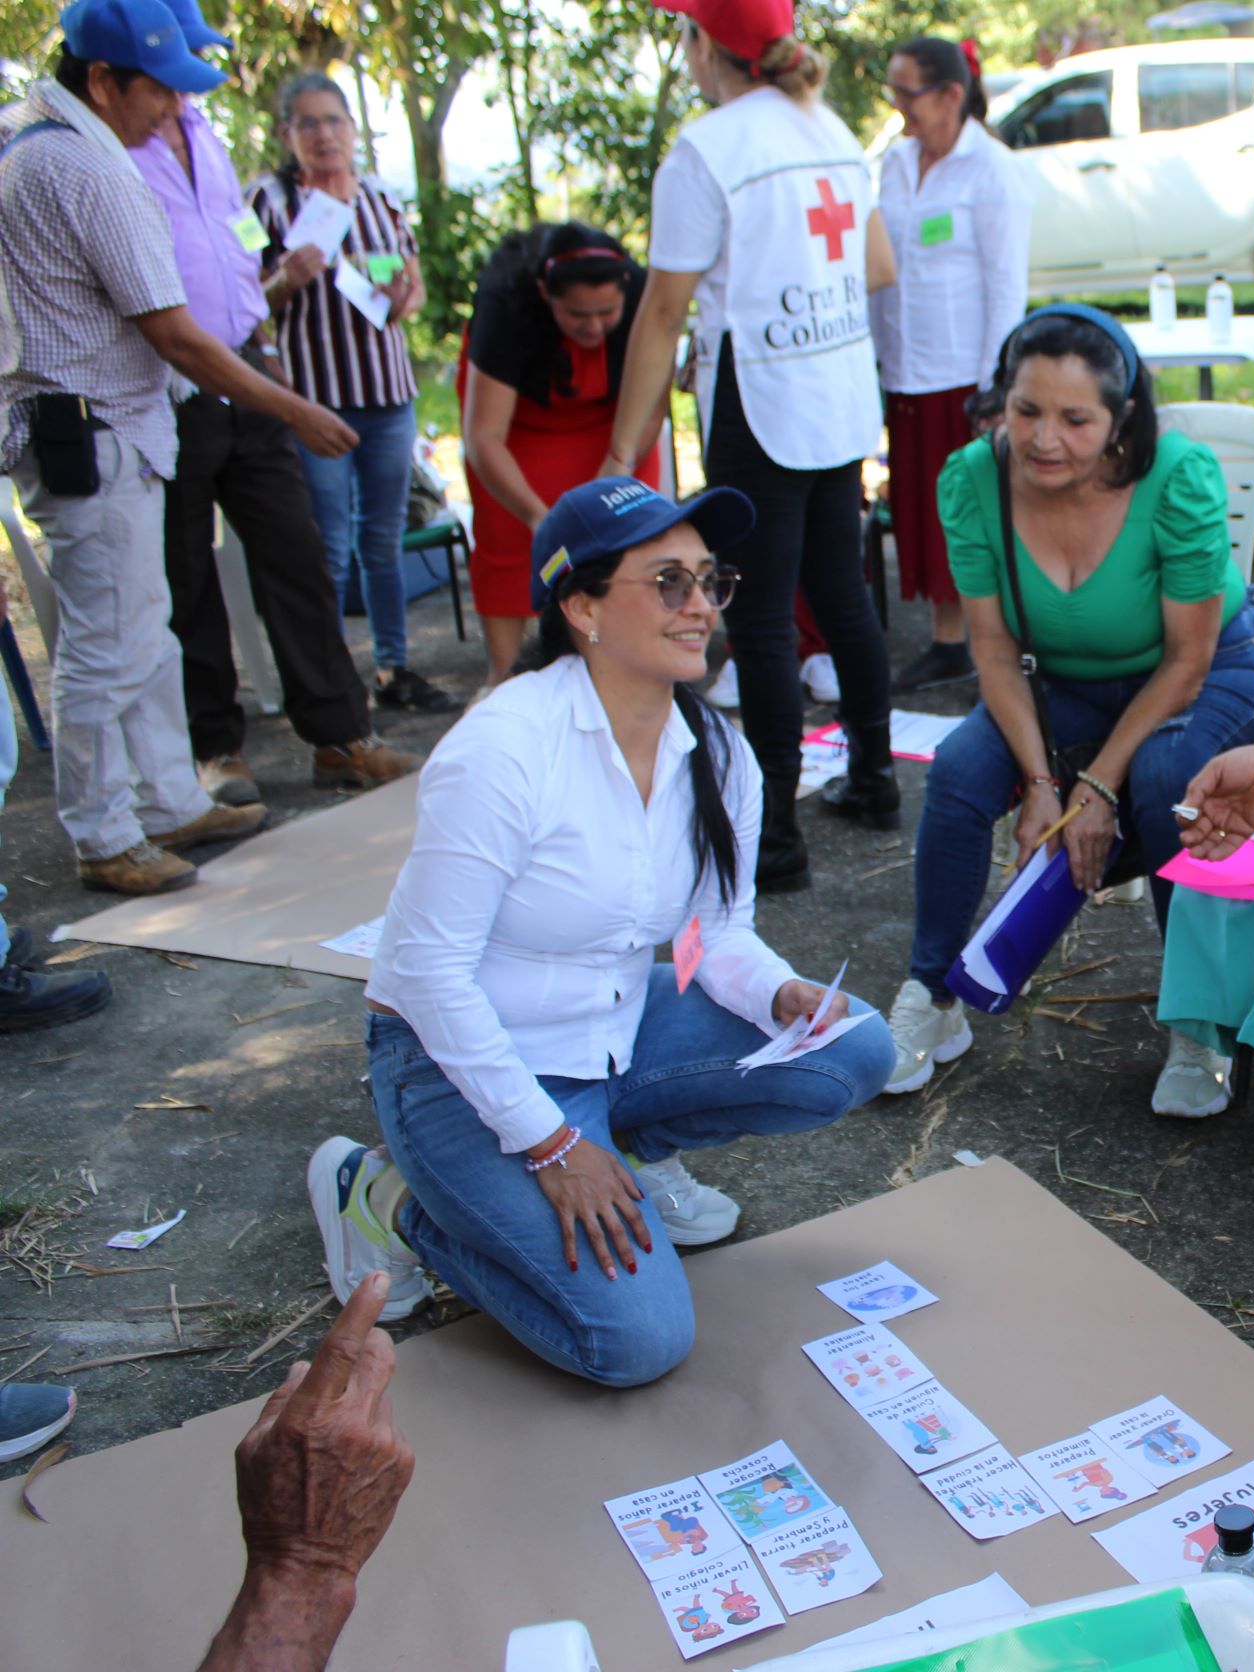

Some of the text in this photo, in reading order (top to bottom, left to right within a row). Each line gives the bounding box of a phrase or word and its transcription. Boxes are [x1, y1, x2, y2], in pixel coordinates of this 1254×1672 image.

[600, 484, 647, 509] John
[823, 1329, 866, 1347] animales
[827, 1333, 876, 1355] Alimentar
[867, 1386, 940, 1418] alguien en casa
[886, 1398, 935, 1420] Cuidar de
[1037, 1439, 1090, 1461] alimentos
[721, 1455, 769, 1478] cosecha
[729, 1462, 777, 1486] Recoger
[937, 1456, 998, 1487] en la ciudad
[986, 1459, 1018, 1477] Hacer
[617, 1489, 702, 1522] Reparar daños
[631, 1489, 675, 1507] en casa
[773, 1515, 831, 1543] y Sembrar
[760, 1541, 796, 1557] tierra
[660, 1559, 751, 1600] Llevar niños al
[677, 1561, 724, 1582] colegio
